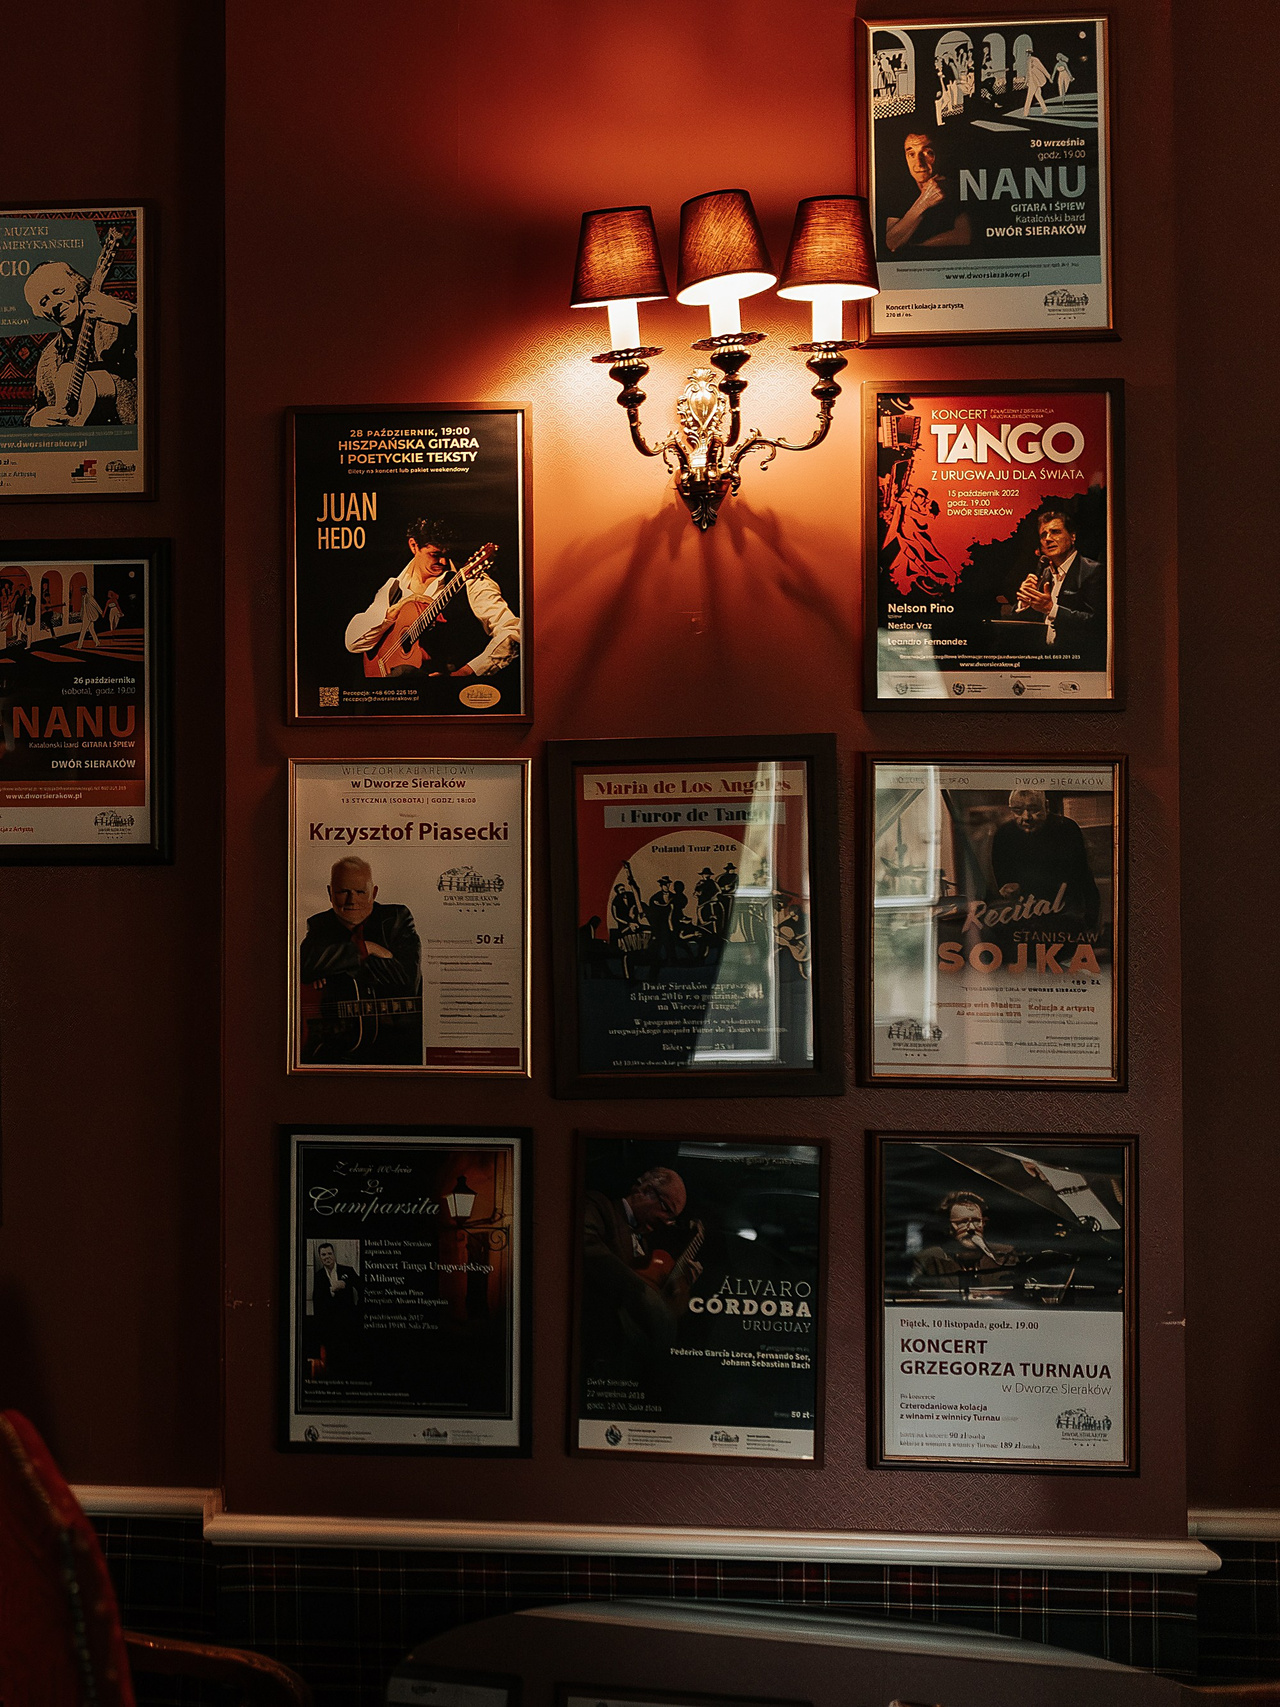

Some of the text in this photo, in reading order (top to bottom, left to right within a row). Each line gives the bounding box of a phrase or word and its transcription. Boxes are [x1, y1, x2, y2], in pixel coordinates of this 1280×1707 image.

[1030, 138, 1085, 148] 30 września
[1037, 151, 1061, 161] godz.
[959, 165, 1086, 201] NANU
[1011, 200, 1085, 213] GITARA ŚPIEW
[1015, 213, 1085, 223] Kataloński bard
[4, 226, 49, 237] MUZYKI
[986, 223, 1087, 238] DWÓR SIERAKÓW
[945, 271, 1030, 280] www.dworsierakow.pl
[886, 302, 964, 311] Koncert kolacja artystą
[931, 409, 987, 420] KONCERT
[349, 426, 470, 438] 28 PAŹDZIERNIK, 19:00
[338, 437, 480, 451] HISZPAŃSKA GITARA
[930, 422, 1086, 464] TANGO
[348, 451, 478, 465] POETYCKIE TEKSTY
[430, 466, 470, 474] weekendowy
[931, 467, 1085, 481] Z URUGWAJU DLA ŚWIATA
[947, 489, 1019, 498] 15 październik 2022
[316, 491, 378, 523] JUAN
[947, 499, 990, 508] godz. 19.00
[947, 507, 1013, 516] DWÓR SIERAKÓW
[317, 526, 366, 550] HEDO
[887, 603, 955, 614] Nelson Pino
[887, 621, 933, 630] Nestor Vaz
[923, 638, 968, 646] Fernandez
[73, 676, 136, 685] 26 października
[12, 705, 136, 739] NANU
[81, 739, 136, 749] GITARA ŚPIEW
[51, 758, 136, 769] DWÓR SIERAKÓW
[351, 777, 466, 789] w Dworze Sieraków
[595, 780, 649, 796] Maria
[653, 781, 676, 794] de
[682, 780, 712, 794] Los
[5, 792, 83, 800] www.dworsierakow.pl
[630, 808, 709, 823] Furor de
[309, 821, 509, 845] Krzysztof Piasecki
[651, 844, 737, 854] Poland Tour 2016
[962, 882, 1068, 934] Recital
[476, 934, 490, 944] 50
[492, 934, 504, 944] zł
[1013, 930, 1099, 944] STANISŁAW
[937, 941, 1102, 975] SOJKA
[309, 1186, 441, 1222] Cumparsita
[364, 1260, 494, 1274] Koncert Tanga Urugwajskiego
[720, 1275, 812, 1298] ÁLVARO
[688, 1293, 812, 1318] CÓRDOBA
[742, 1319, 812, 1334] URUGUAY
[932, 1320, 943, 1328] 10
[988, 1321, 1013, 1331] godz.
[1016, 1321, 1039, 1330] 19.00
[901, 1338, 988, 1354] KONCERT
[670, 1347, 704, 1357] Federico
[731, 1350, 755, 1360] Lorca,
[756, 1351, 793, 1361] Fernando
[794, 1353, 811, 1363] Sor,
[720, 1358, 811, 1370] Johann Sebastian Bach
[900, 1360, 1112, 1379] GRZEGORZA TURNAUA
[1002, 1382, 1112, 1395] w Dworze Sieraków
[900, 1402, 987, 1412] Czterodaniowa kolacja
[791, 1410, 801, 1419] 50
[941, 1413, 971, 1422] winnicy
[972, 1413, 1001, 1421] Turnau
[949, 1431, 959, 1439] 90
[1000, 1441, 1013, 1449] 189
